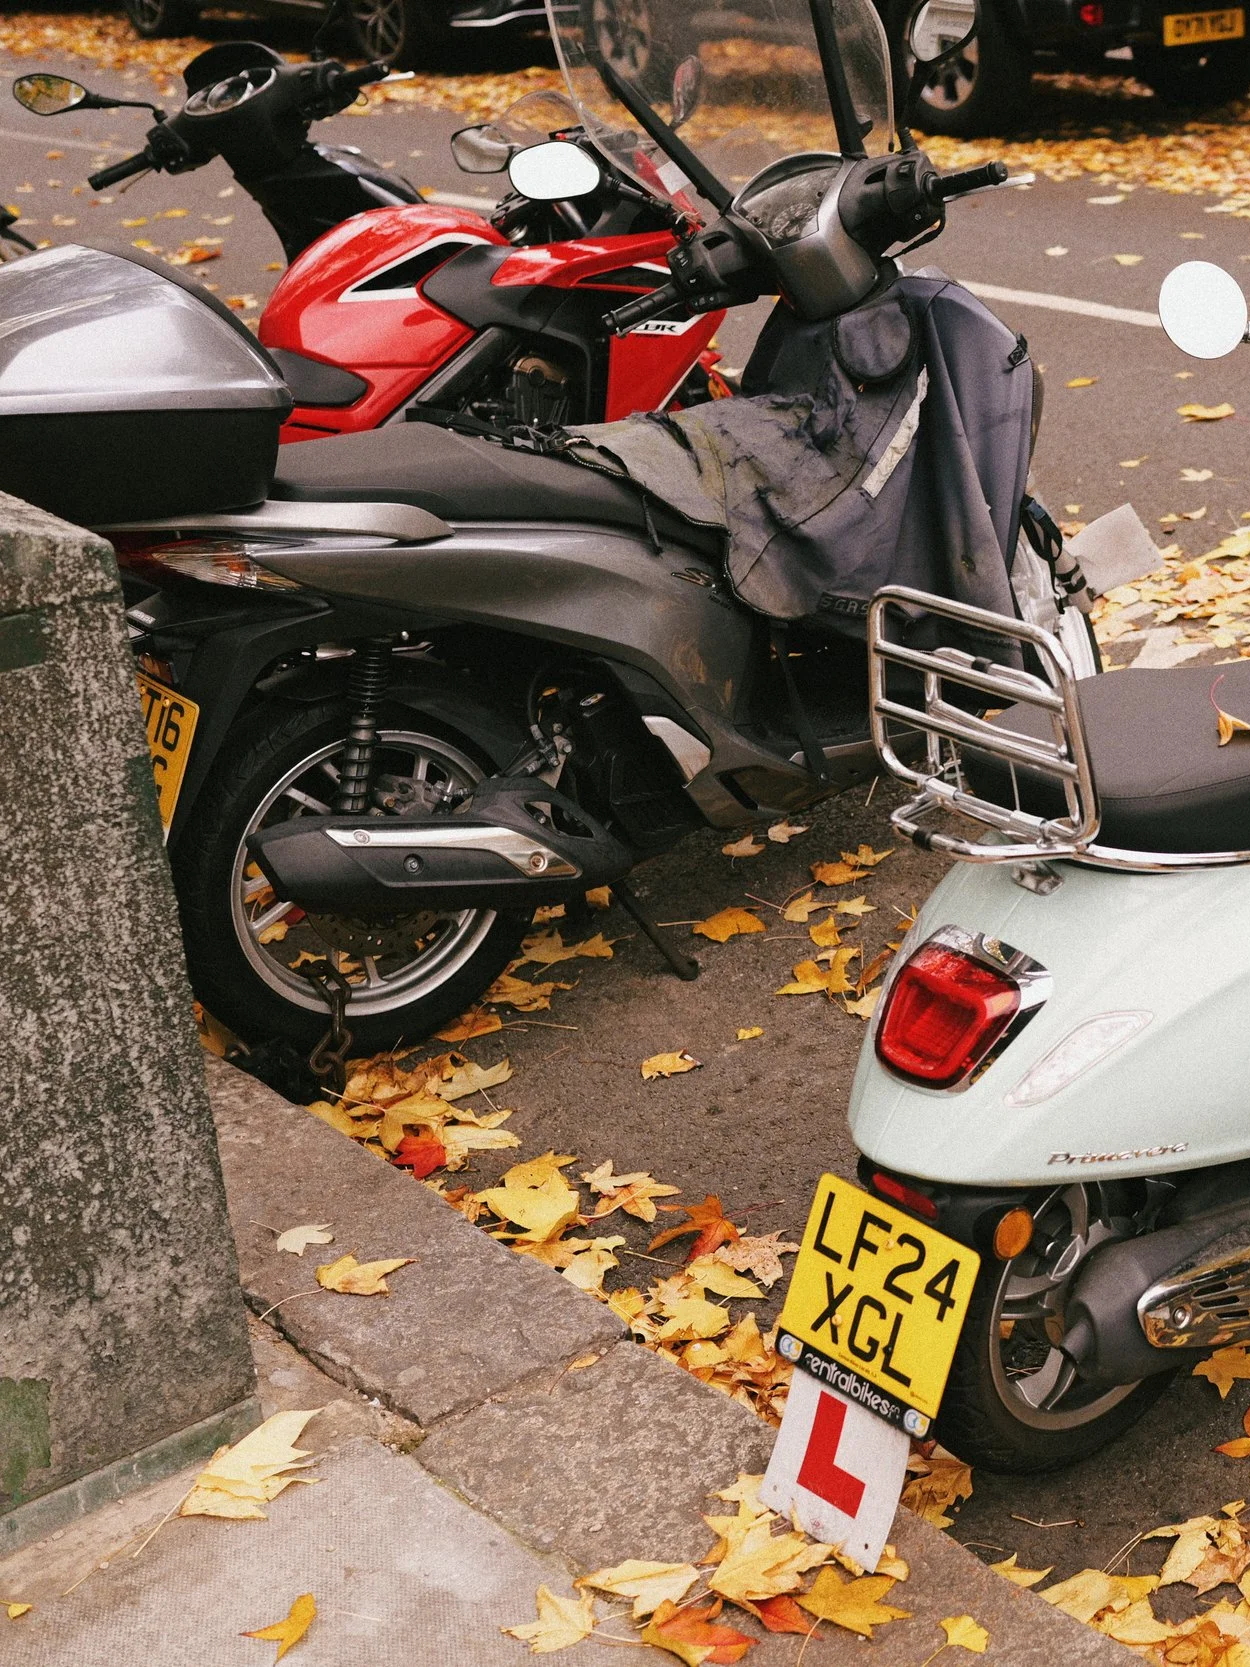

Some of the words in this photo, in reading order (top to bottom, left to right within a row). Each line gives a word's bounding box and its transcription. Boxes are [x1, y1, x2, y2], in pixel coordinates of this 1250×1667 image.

[1047, 1142, 1189, 1165] Primavera
[813, 1191, 960, 1322] LF24
[811, 1271, 912, 1389] XGL
[796, 1390, 866, 1519] L
